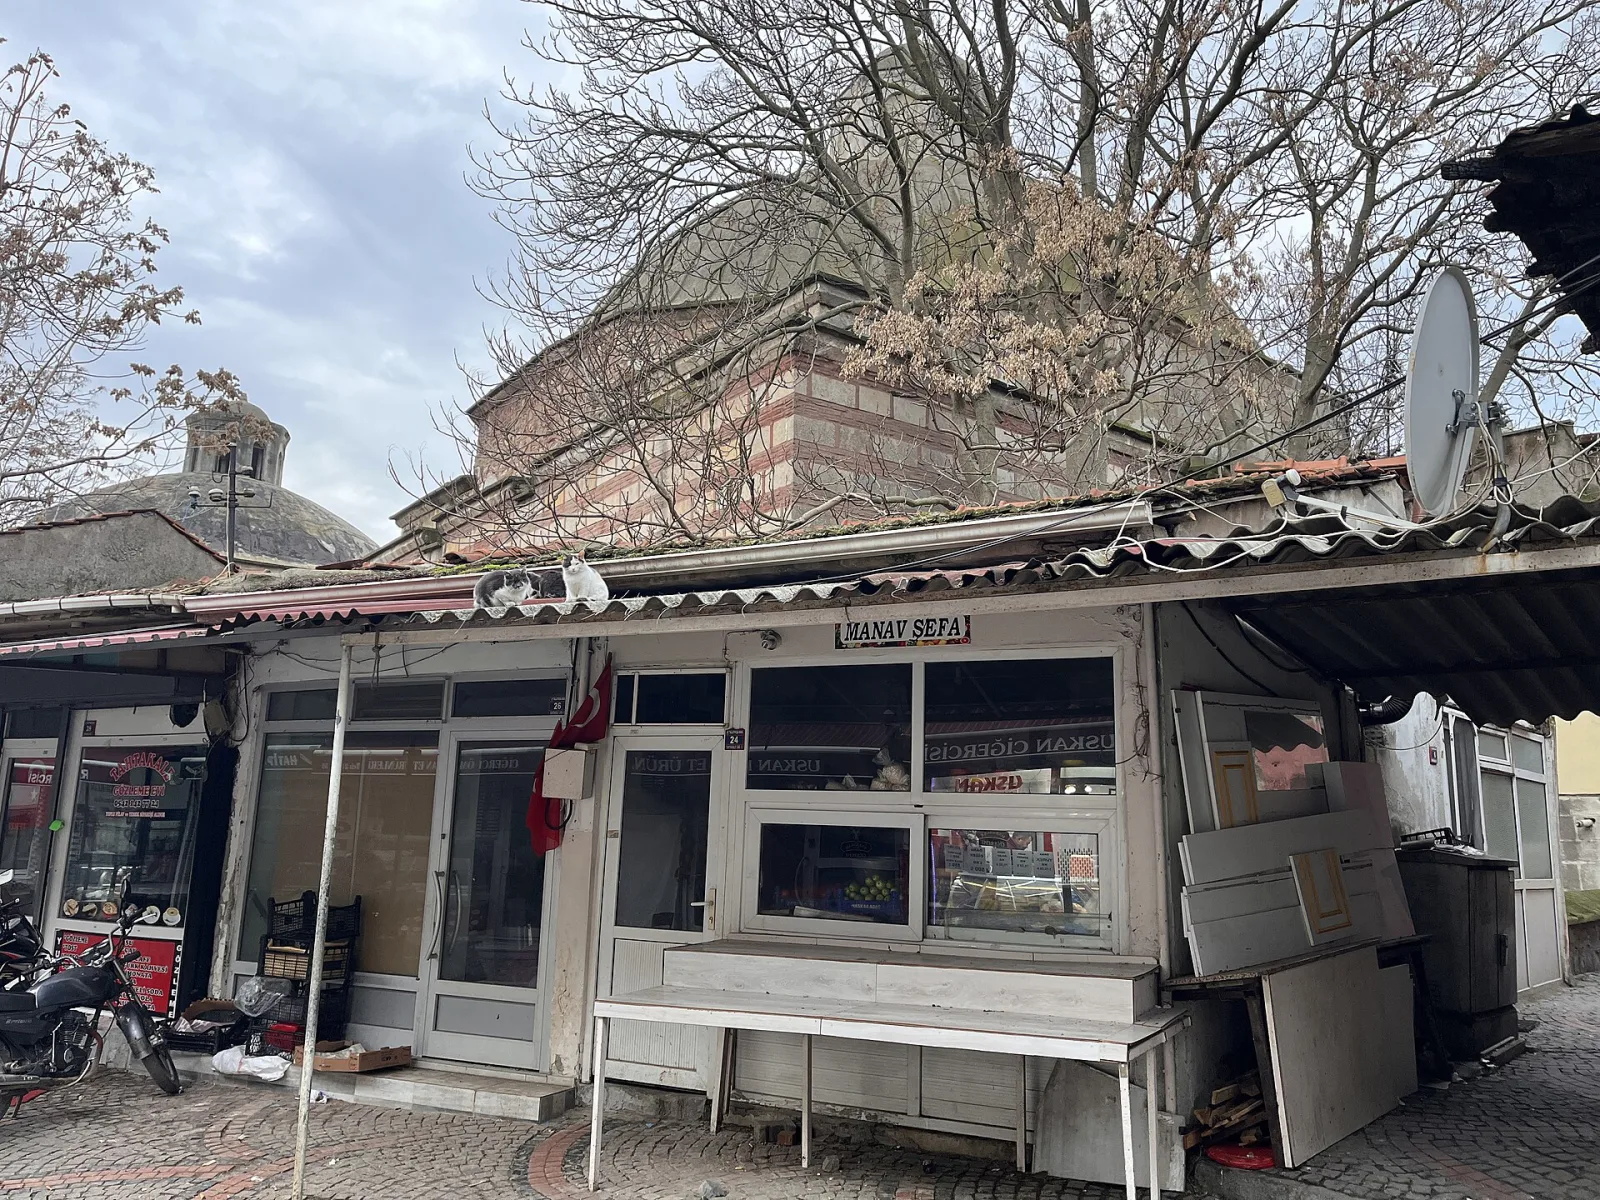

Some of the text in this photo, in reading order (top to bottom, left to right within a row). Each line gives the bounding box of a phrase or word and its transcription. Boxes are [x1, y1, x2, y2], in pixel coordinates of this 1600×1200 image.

[844, 619, 909, 641] MANAV
[553, 702, 562, 710] 26
[729, 735, 739, 744] 24
[109, 751, 176, 782] TAHTAKALE
[113, 784, 150, 796] GÖZLEME
